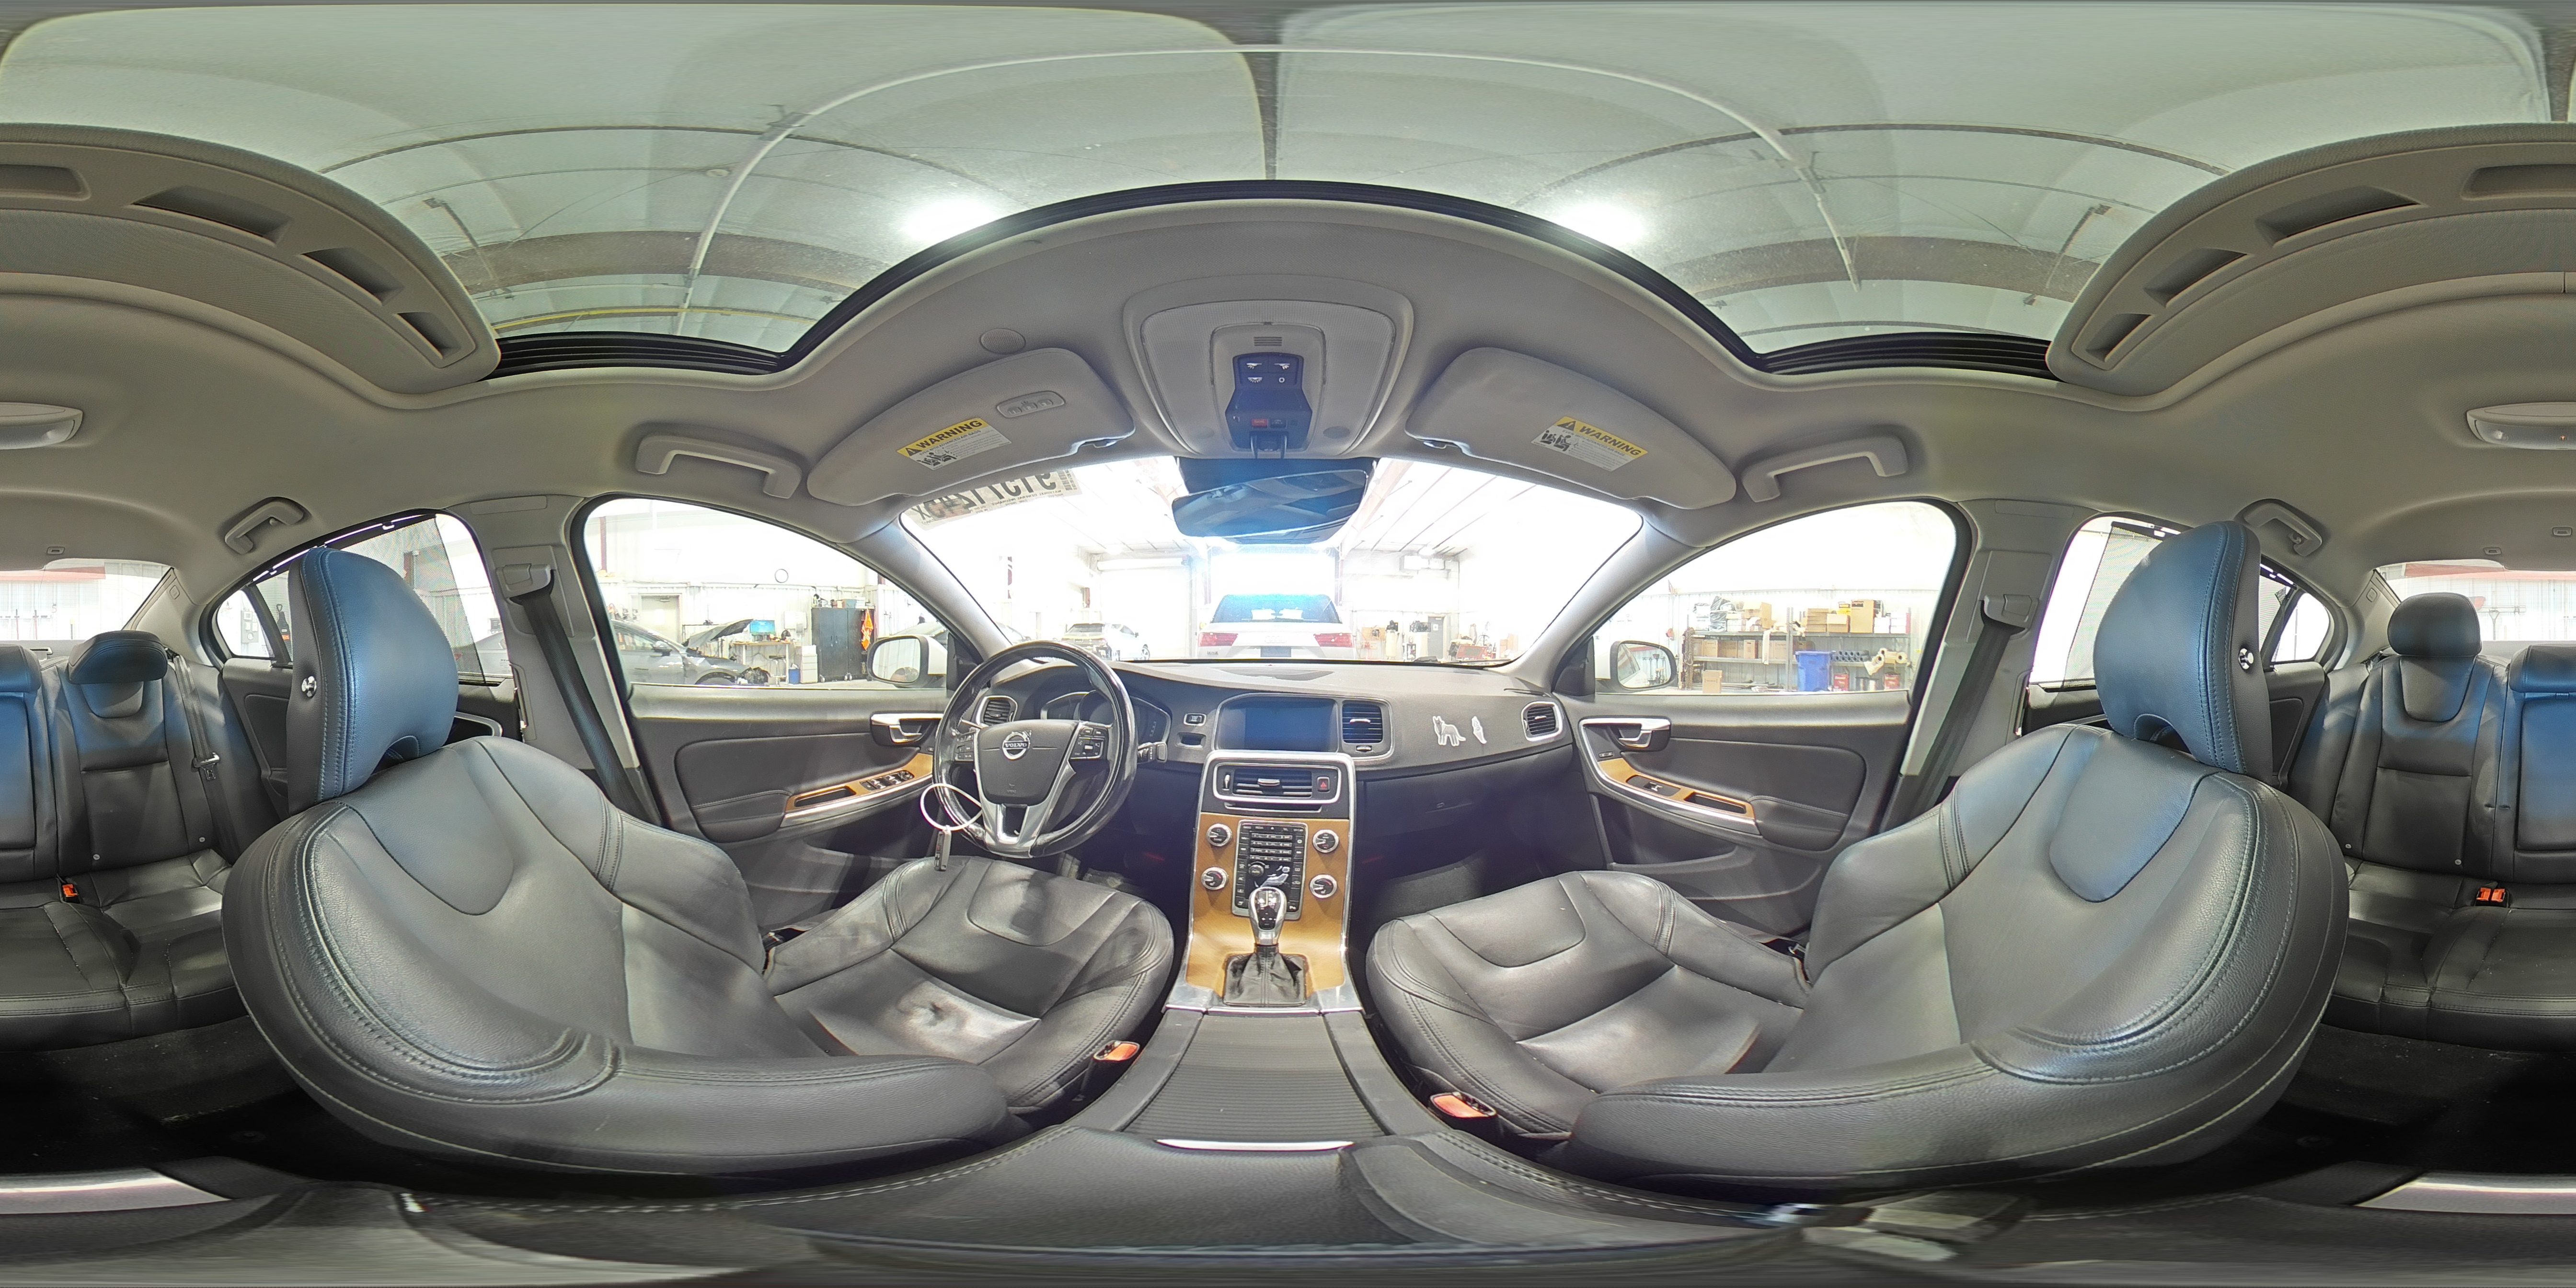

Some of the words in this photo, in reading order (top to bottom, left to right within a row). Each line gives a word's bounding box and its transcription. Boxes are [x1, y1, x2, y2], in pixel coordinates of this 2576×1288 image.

[916, 420, 982, 448] WARNING
[939, 437, 960, 448] ADVANCED
[1579, 426, 1642, 456] WARNING
[1586, 437, 1607, 449] ADVANCED
